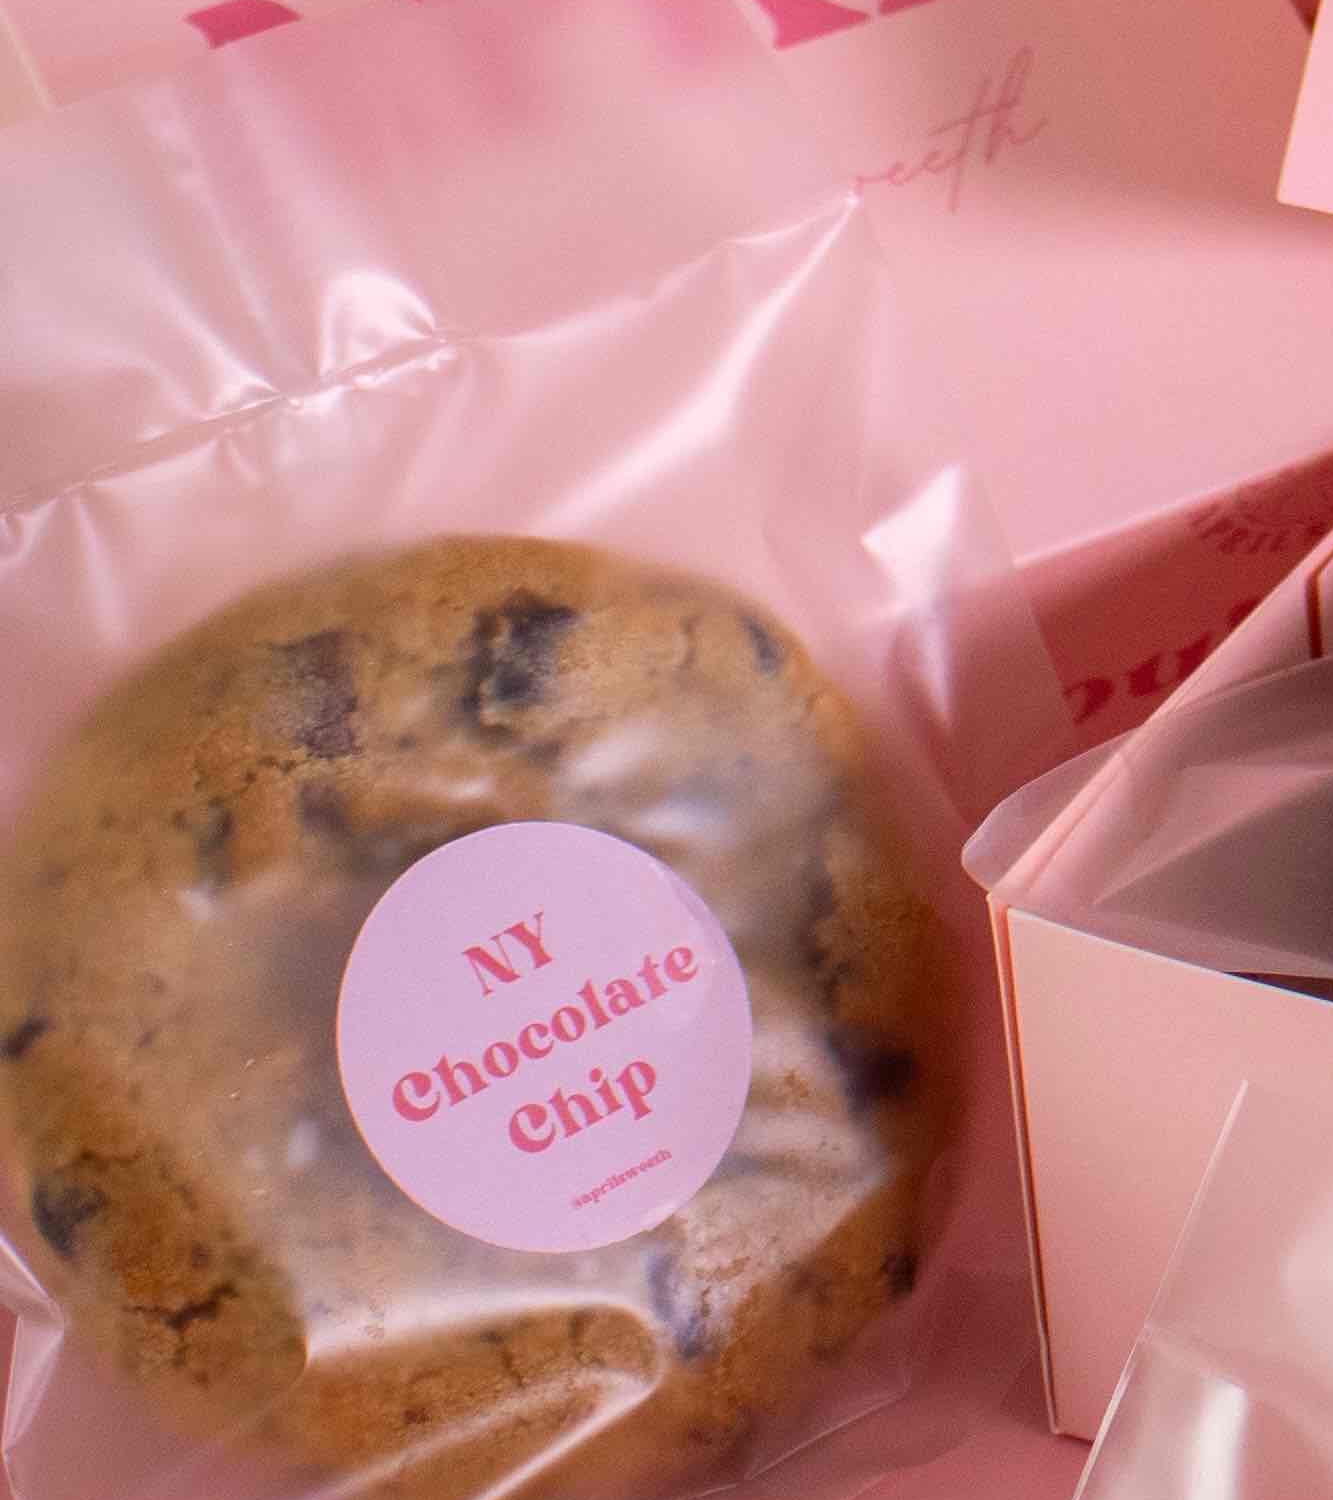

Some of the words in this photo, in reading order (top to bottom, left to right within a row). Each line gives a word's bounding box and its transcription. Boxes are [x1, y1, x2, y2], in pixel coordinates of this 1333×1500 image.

[462, 912, 553, 997] NY
[392, 945, 700, 1122] Chocolate
[508, 1059, 657, 1153] Chip
